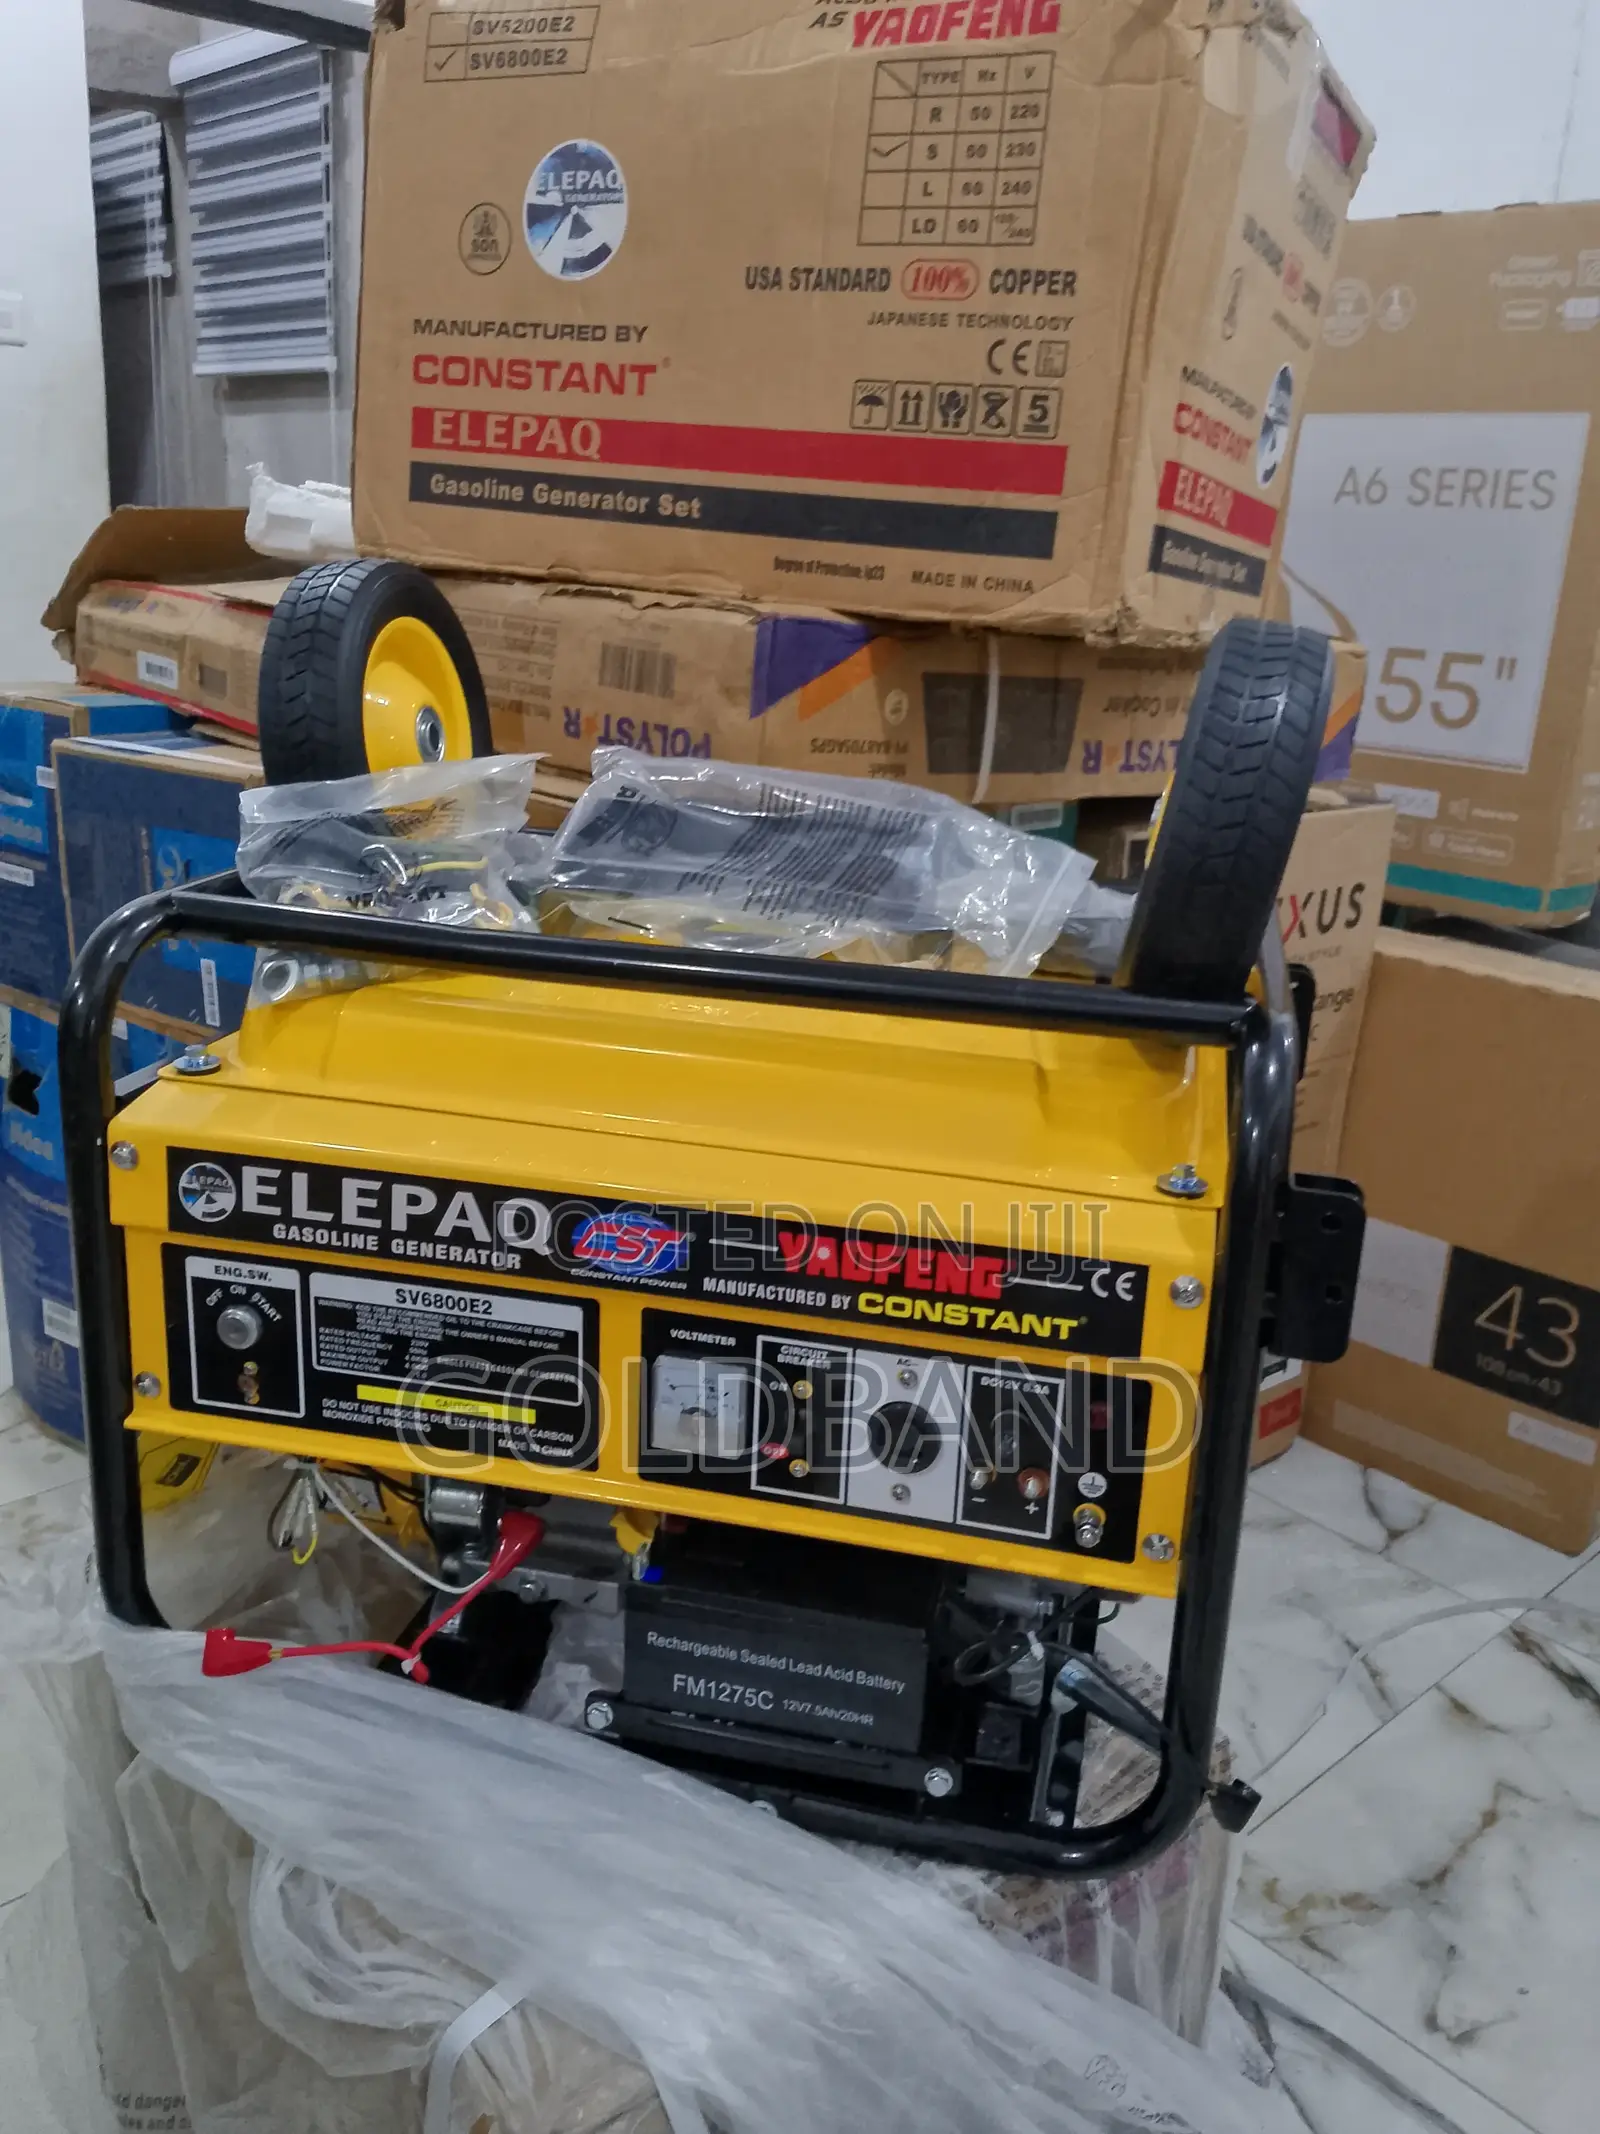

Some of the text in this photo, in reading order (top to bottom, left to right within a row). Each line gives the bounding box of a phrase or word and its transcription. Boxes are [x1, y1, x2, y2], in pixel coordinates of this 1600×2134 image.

[472, 15, 576, 36] SV5200E2
[808, 0, 1061, 48] AS YAOFENG
[469, 47, 568, 71] SV6800E2
[921, 71, 961, 85] TYPE
[1024, 66, 1037, 79] V
[929, 106, 943, 124] R
[926, 143, 938, 161] S
[536, 169, 624, 191] ELEPAQ
[922, 181, 933, 197] L
[1001, 180, 1033, 196] 240
[745, 264, 1077, 297] USA STANDARD 100% COPPER
[412, 318, 649, 343] MANUFACTURED BY
[867, 311, 1075, 332] JAPANESE TECHNOLOGY
[987, 338, 1032, 376] CE
[412, 354, 657, 397] CONSTANT
[432, 409, 602, 461] ELEPAQ
[430, 473, 702, 519] Gasoline Generator Set
[1334, 467, 1558, 511] A6 SERIES
[911, 570, 1034, 594] MADE IN CHINA
[242, 1166, 555, 1257] ELEPAQ
[273, 1222, 522, 1270] GASOLINE GENERATOR
[214, 1264, 272, 1283] ENG.SW.
[570, 1267, 688, 1290] CONSTANT POWER
[778, 1231, 1018, 1300] YAOFENG
[1090, 1267, 1138, 1302] CE
[229, 1284, 247, 1296] ON
[250, 1291, 283, 1323] START
[395, 1288, 493, 1315] SV6800E2
[702, 1276, 1079, 1341] MANUFACTURED BY CONSTANT
[669, 1328, 737, 1346] VOLTMETER
[1474, 1283, 1581, 1369] 43
[777, 1354, 832, 1370] BREAKER
[780, 1344, 829, 1360] CIRCUIT
[769, 1380, 788, 1393] ON
[322, 1409, 375, 1425] MONOXIDE
[322, 1397, 338, 1409] DO
[339, 1400, 360, 1412] NOT
[361, 1404, 382, 1415] USE
[453, 1418, 468, 1429] TO
[529, 1428, 575, 1443] CARBON
[498, 1438, 529, 1452] MADE
[540, 1445, 575, 1459] CHINA
[647, 1631, 906, 1695] Rechargeable Sealed Lead Acid Battery
[673, 1672, 775, 1711] FM1275C
